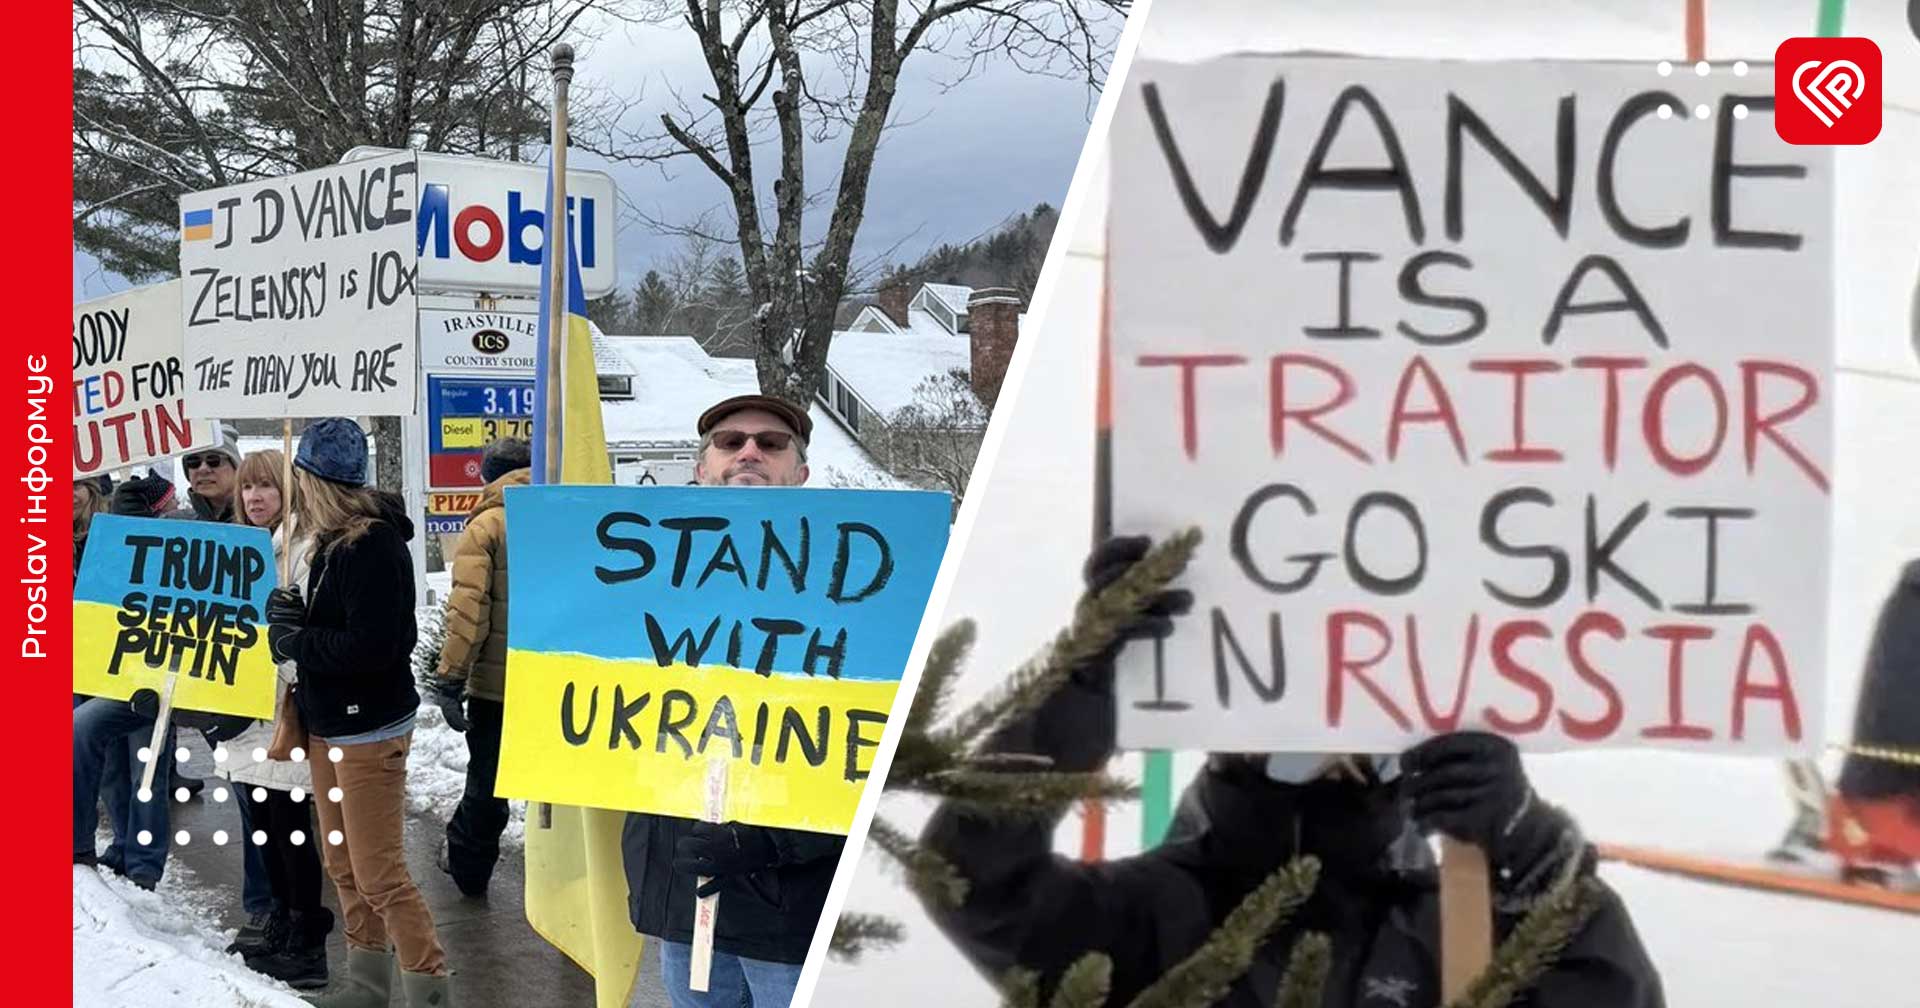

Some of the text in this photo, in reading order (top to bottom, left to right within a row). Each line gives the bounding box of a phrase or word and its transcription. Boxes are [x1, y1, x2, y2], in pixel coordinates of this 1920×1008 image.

[1141, 77, 1807, 256] VANCE
[215, 161, 415, 249] J D VANCE
[189, 262, 325, 327] ZELENSKY
[444, 314, 536, 336] IRASVILLE
[1303, 250, 1668, 348] IS A
[195, 344, 403, 399] THE MAN YOU ARE
[445, 355, 498, 366] COUNTRY
[479, 335, 505, 349] ICS
[132, 357, 183, 401] FOR
[442, 387, 534, 414] Regular 3.19
[443, 424, 473, 436] Diesel
[1136, 354, 1831, 494] TRAITOR
[125, 535, 265, 600] TRUMP
[594, 511, 894, 604] STAND
[1230, 483, 1757, 614] GO SKI
[117, 592, 259, 649] SERVES
[645, 612, 847, 679] WITH
[107, 628, 240, 686] PUTIN
[1132, 607, 1803, 742] IN RUSSIA
[561, 681, 890, 782] UKRAINE
